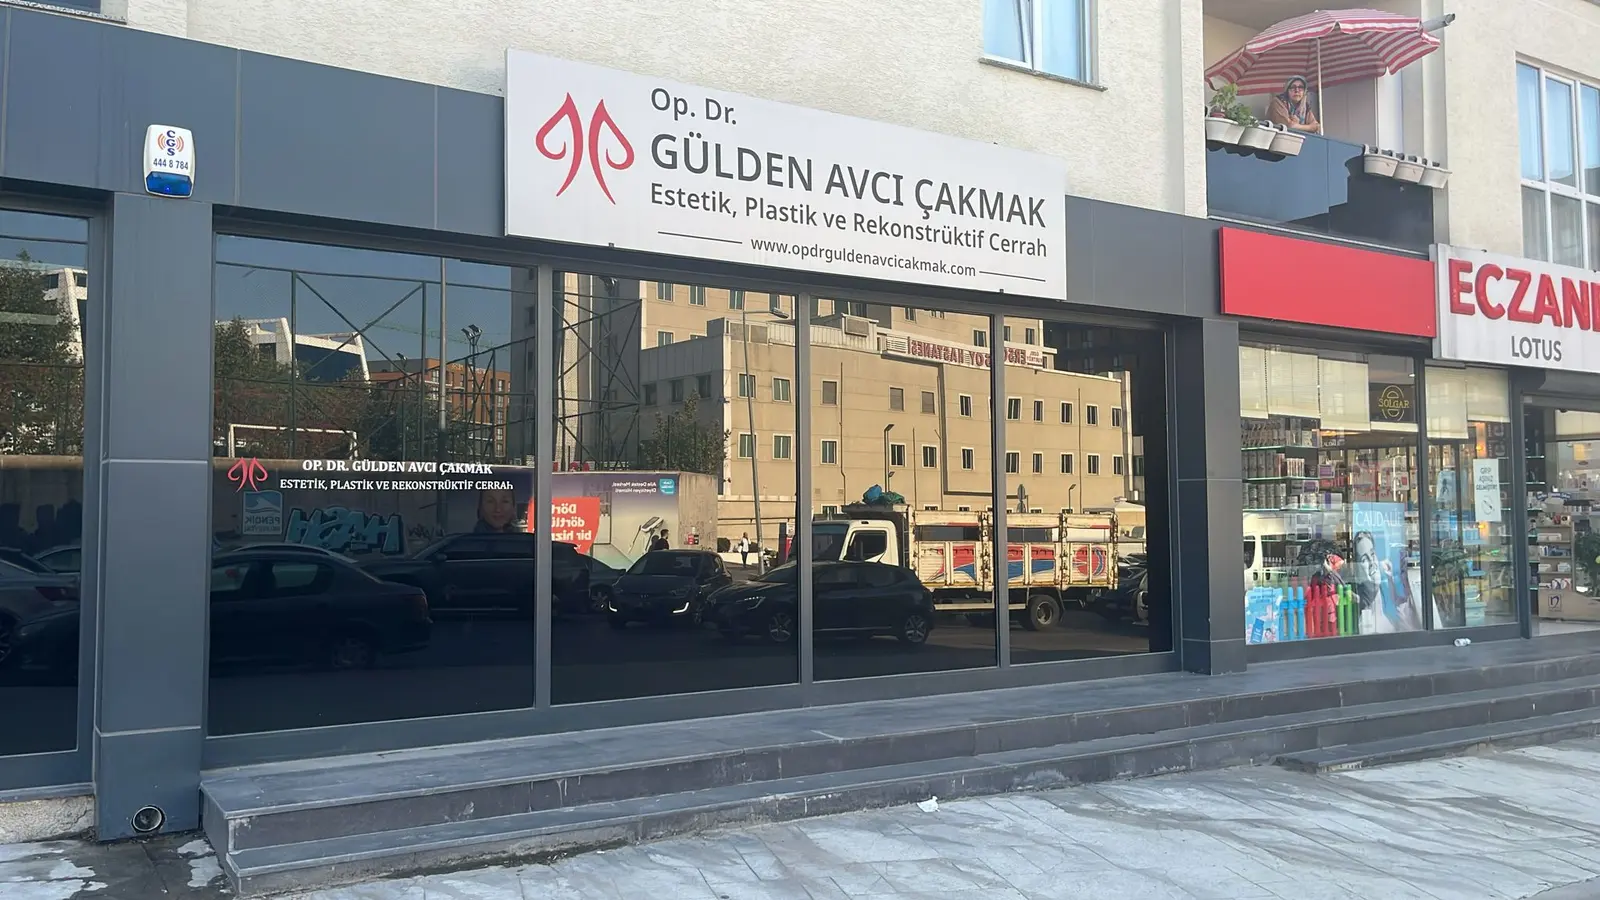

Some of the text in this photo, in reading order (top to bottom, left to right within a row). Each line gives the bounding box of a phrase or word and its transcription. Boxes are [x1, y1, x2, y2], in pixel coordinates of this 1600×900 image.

[651, 87, 737, 125] Op. Dr.
[166, 130, 176, 156] CGS
[153, 158, 189, 170] 444 8 784
[651, 131, 1047, 228] GÜLDEN AVCI ÇAKMAK
[651, 182, 1048, 258] Estetik, Plastik ve Rekonstrüktif Cerrah
[751, 238, 976, 277] www.opdrguldenavcicakmak.com
[1511, 335, 1562, 362] LOTUS
[1378, 398, 1410, 409] SOLGAR
[302, 458, 493, 476] OP. DR. GÜLDEN AVCI ÇAKMAK
[280, 477, 328, 491] ESTETİK,
[330, 478, 374, 490] PLASTİK
[376, 480, 390, 490] VE
[391, 479, 474, 490] REKONSTRÜKTİF
